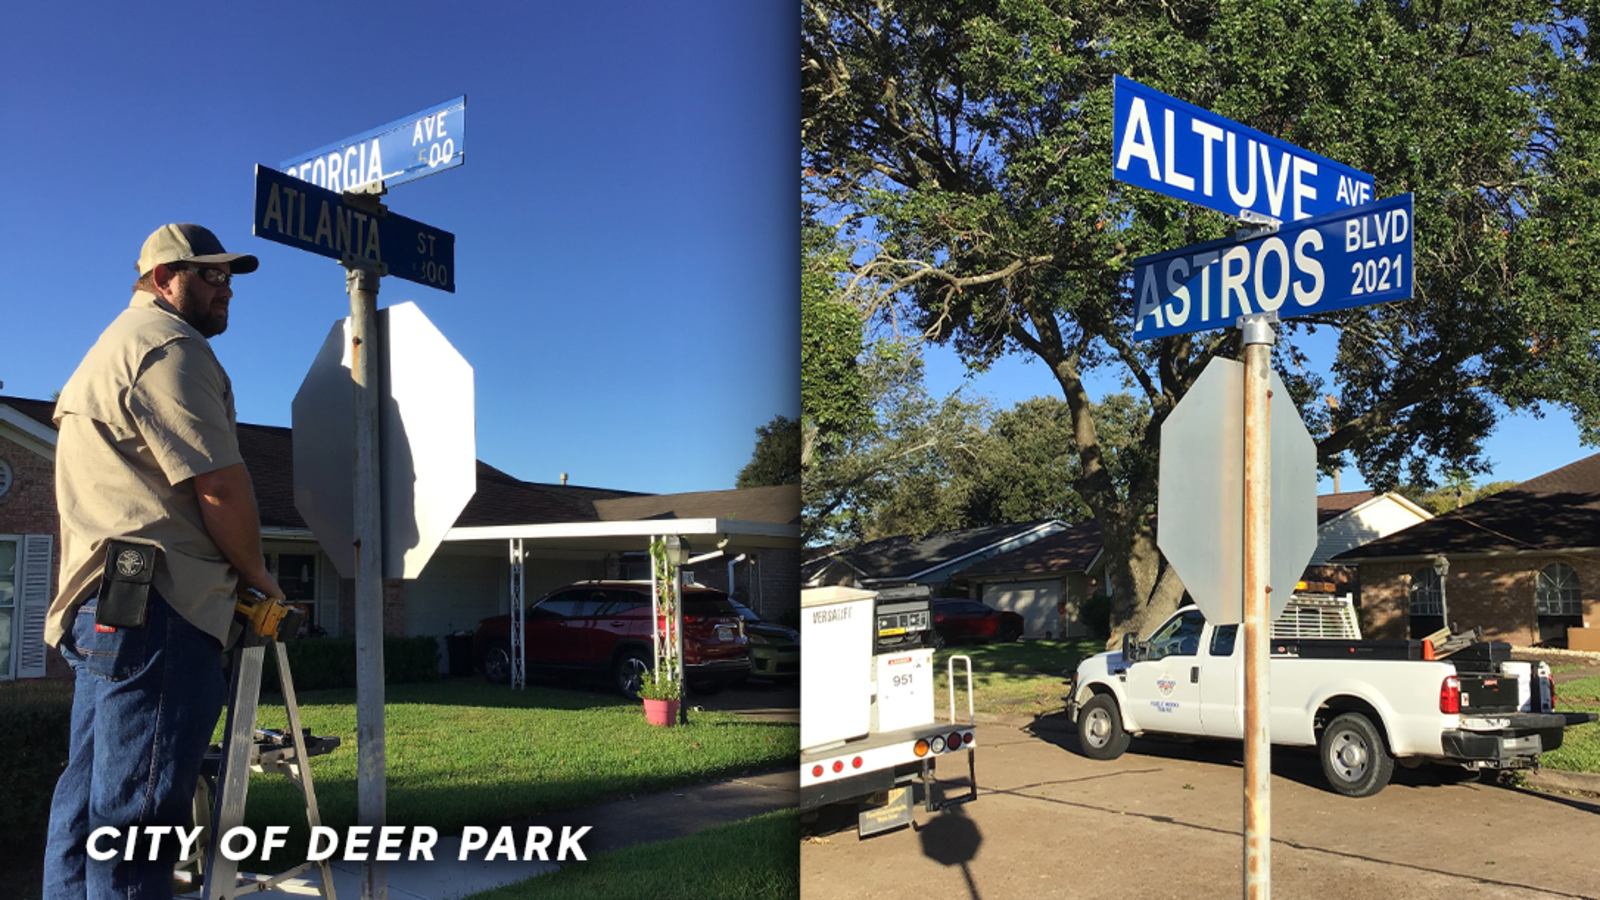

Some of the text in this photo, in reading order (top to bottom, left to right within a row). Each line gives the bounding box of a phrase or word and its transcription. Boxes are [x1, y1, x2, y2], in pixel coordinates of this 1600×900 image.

[286, 111, 447, 194] ORGIA AVE
[1116, 96, 1371, 220] ALTUVE AVE
[263, 182, 436, 261] ATLANTA ST
[1136, 208, 1409, 332] ASTROS BLVD
[1351, 253, 1402, 295] 2021
[893, 674, 913, 687] 951
